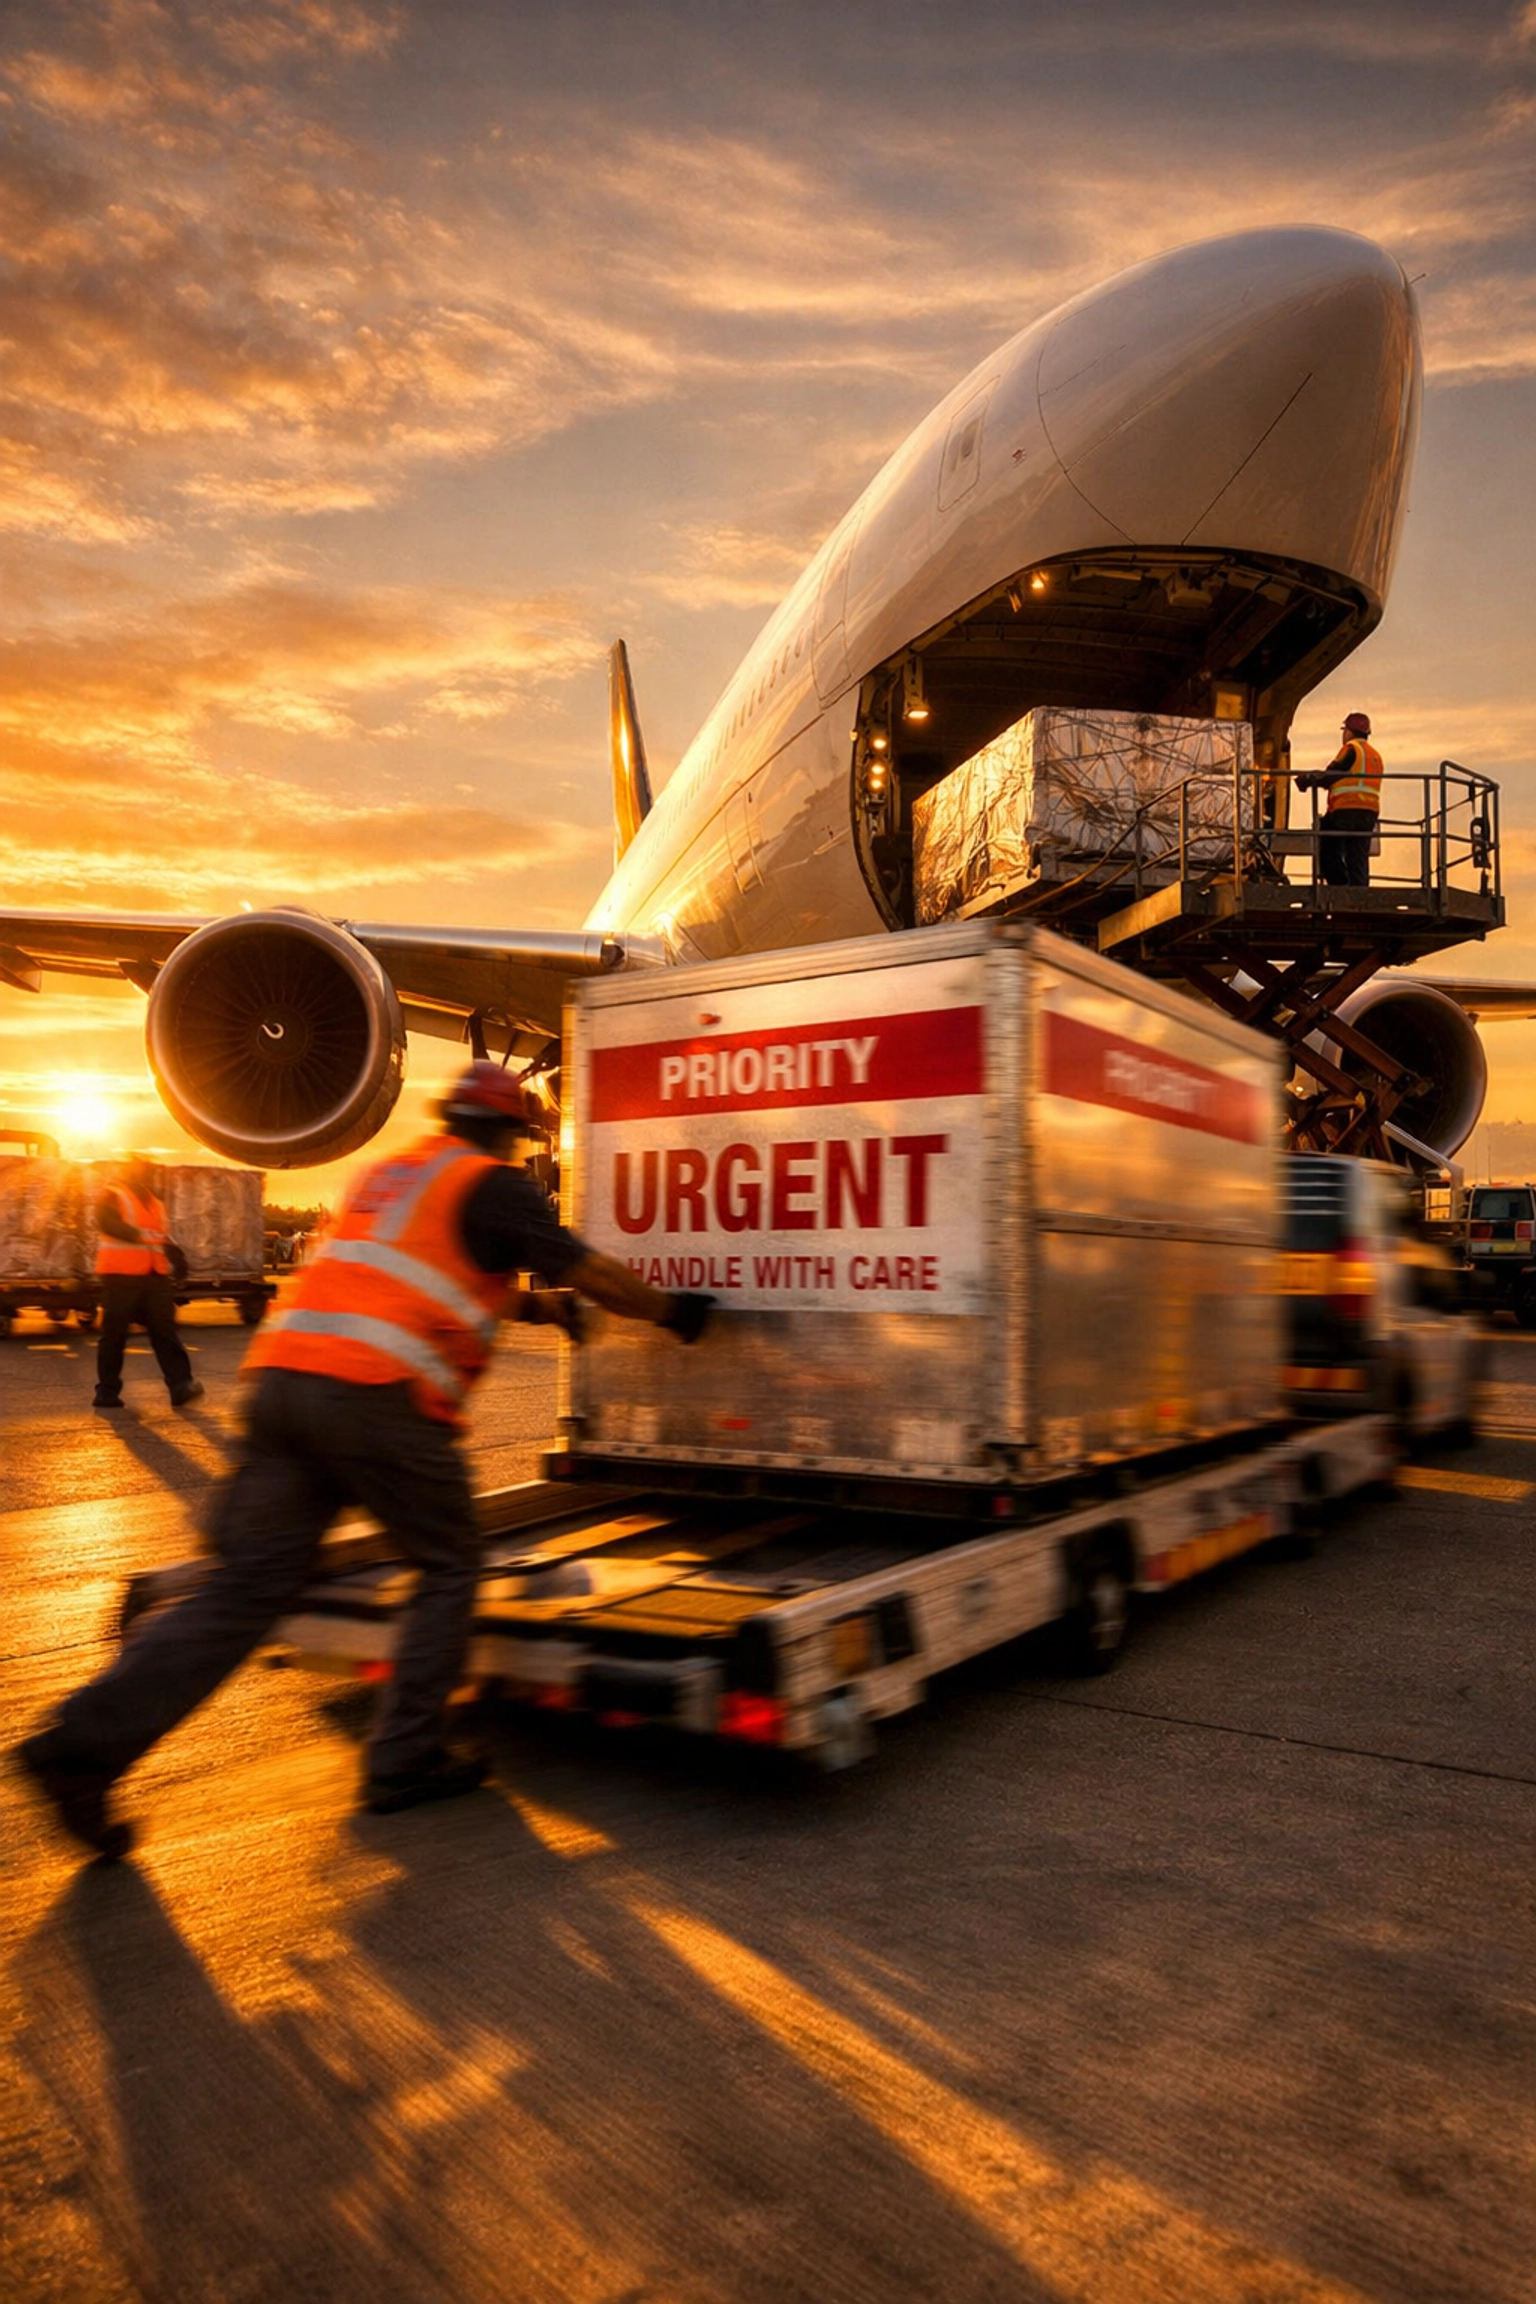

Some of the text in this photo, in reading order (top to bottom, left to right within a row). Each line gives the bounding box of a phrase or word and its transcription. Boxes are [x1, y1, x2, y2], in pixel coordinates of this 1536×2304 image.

[660, 1036, 878, 1100] PRIORITY
[613, 1133, 949, 1234] URGENT
[753, 1255, 835, 1290] WITH
[848, 1255, 940, 1291] CARE
